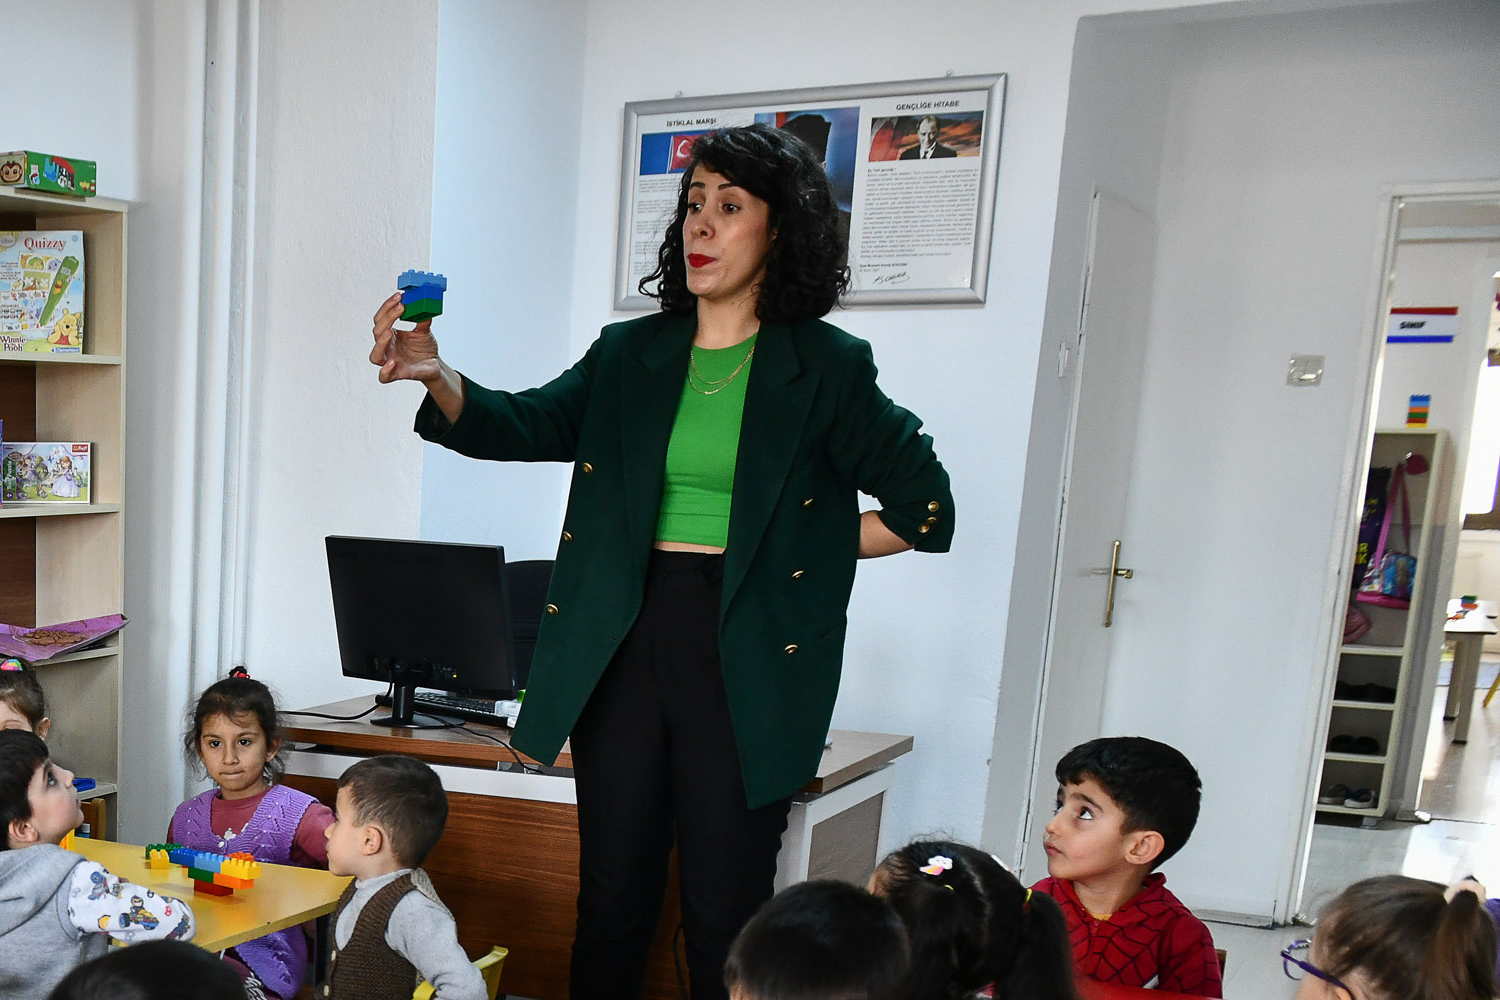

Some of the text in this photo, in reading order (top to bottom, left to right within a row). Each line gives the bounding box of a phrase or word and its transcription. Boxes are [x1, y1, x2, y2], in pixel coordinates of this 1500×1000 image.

[24, 236, 65, 251] Quizzy
[0, 335, 27, 344] Winnie
[3, 343, 23, 352] Pooh
